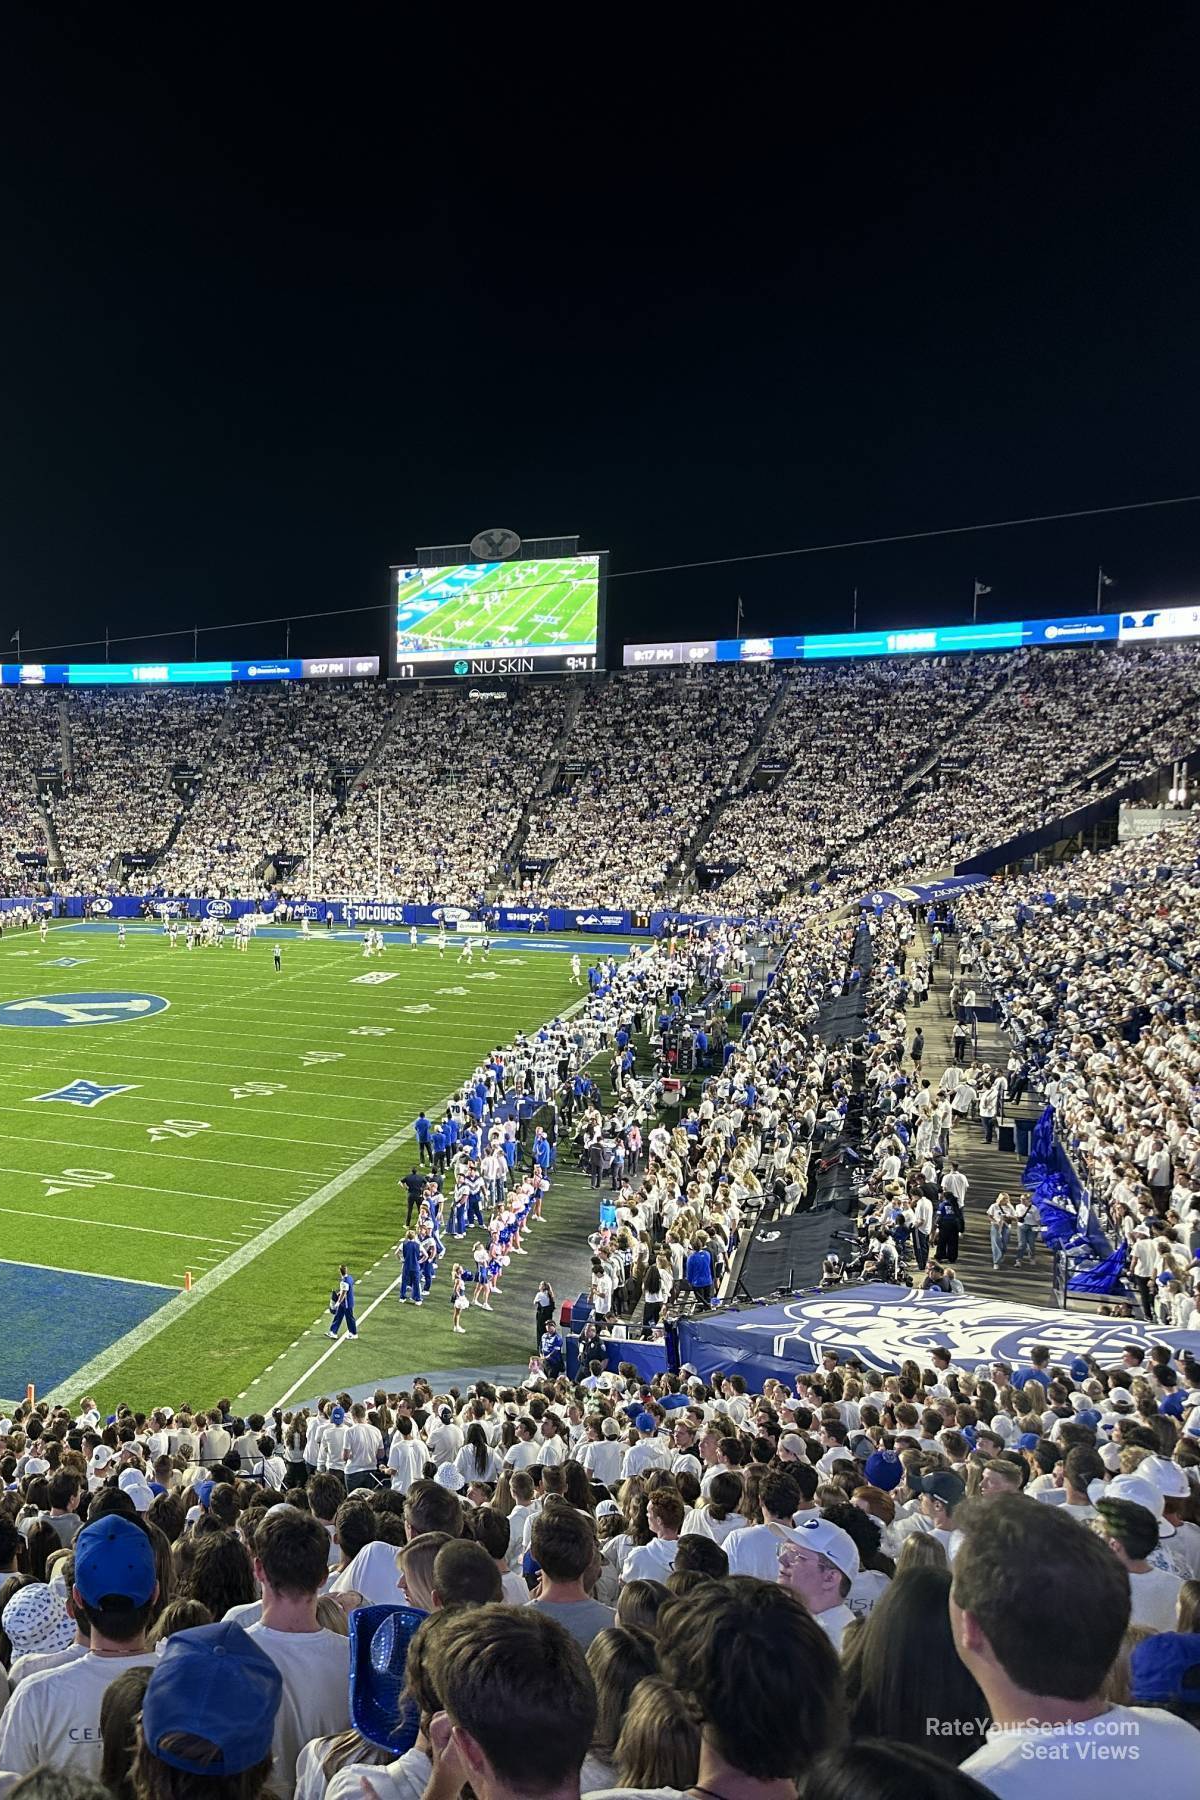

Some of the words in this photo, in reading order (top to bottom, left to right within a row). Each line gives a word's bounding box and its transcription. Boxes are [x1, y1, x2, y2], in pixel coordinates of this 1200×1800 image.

[656, 649, 673, 660] PM
[329, 663, 344, 673] PM
[471, 660, 495, 673] NU
[498, 658, 534, 672] SKIN
[566, 656, 596, 670] 9:41
[401, 665, 414, 677] 17
[931, 886, 965, 898] ZIONS
[966, 881, 992, 892] BANK
[637, 917, 648, 927] 17
[297, 1051, 347, 1066] 40
[229, 1081, 288, 1097] 30
[451, 1105, 461, 1114] 70
[147, 1118, 212, 1138] 20
[40, 1168, 116, 1188] 10
